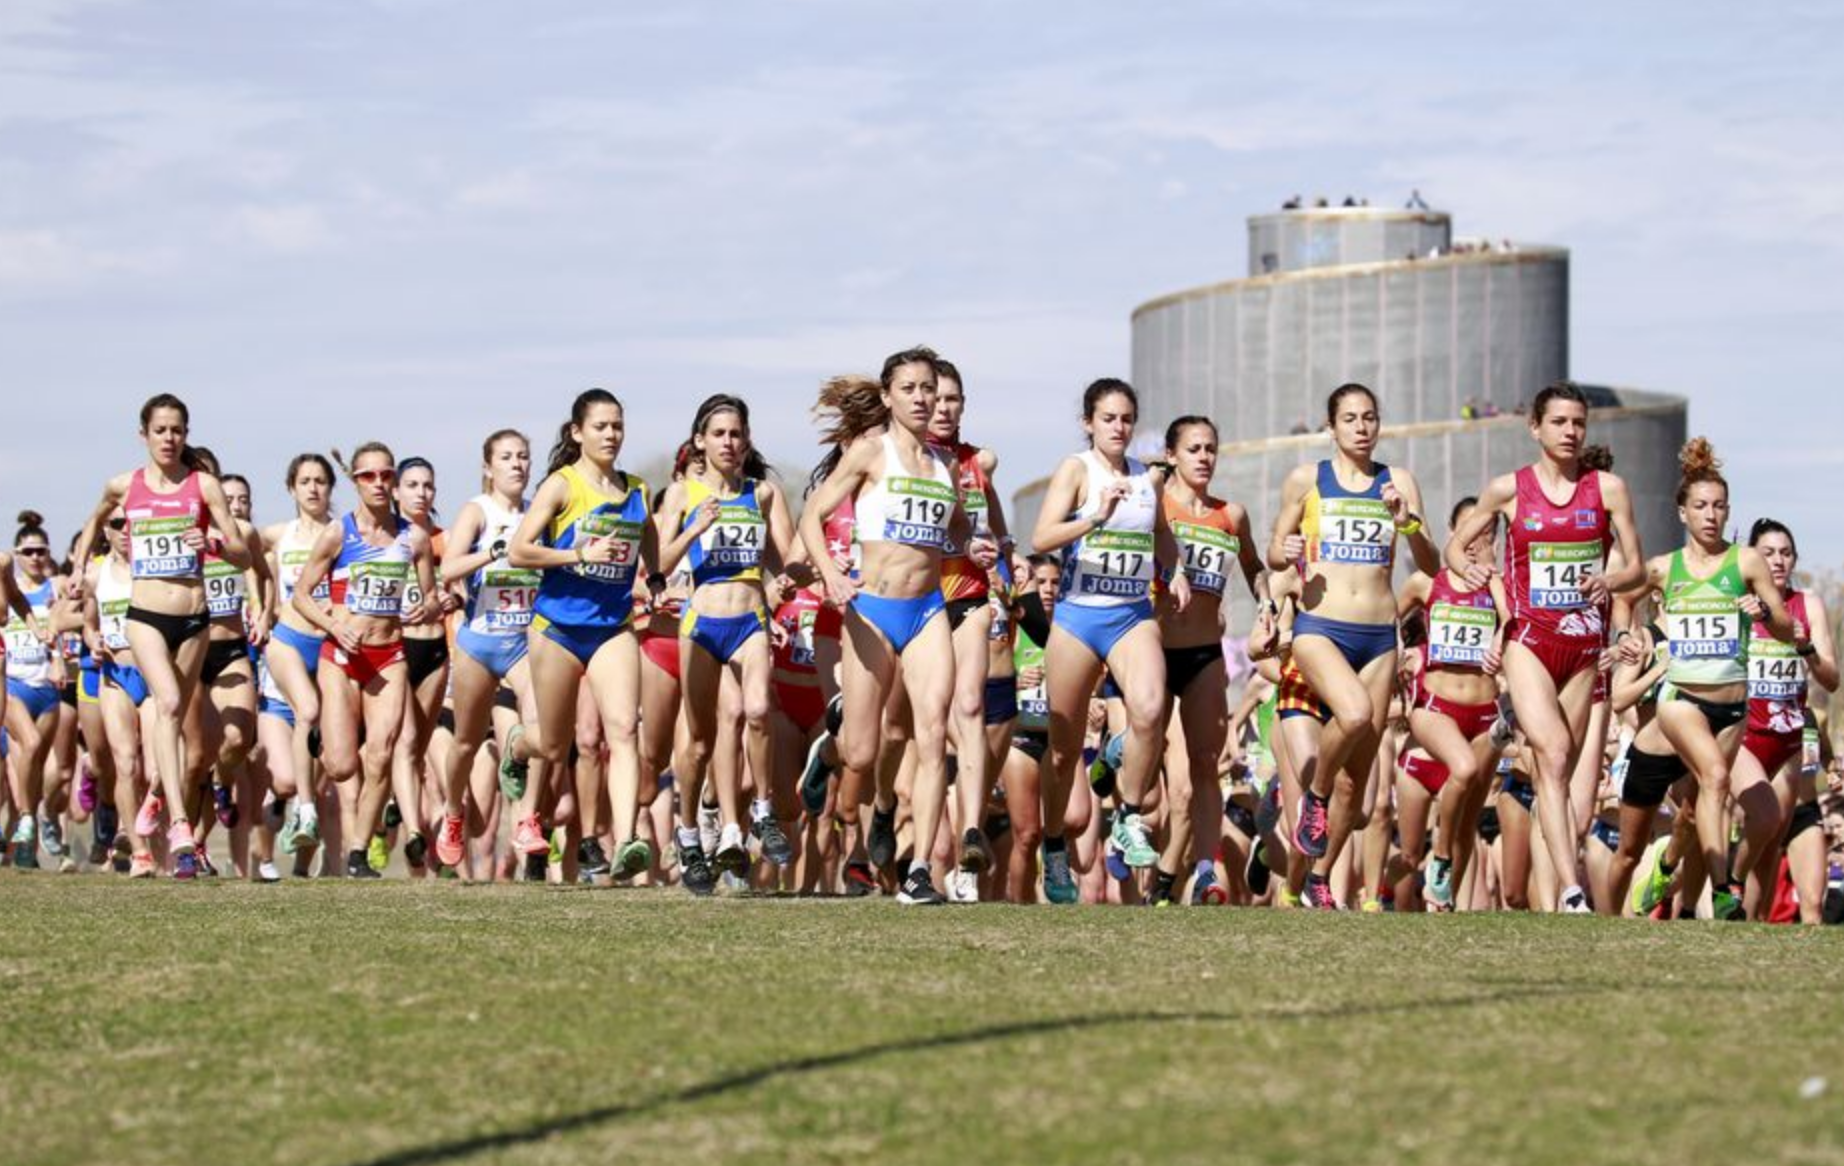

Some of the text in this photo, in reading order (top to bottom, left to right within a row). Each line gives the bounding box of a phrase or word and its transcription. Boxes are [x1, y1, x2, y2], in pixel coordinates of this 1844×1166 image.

[902, 497, 946, 524] 119
[714, 525, 758, 547] 124
[1335, 519, 1383, 543] 152
[143, 535, 184, 556] 191
[1099, 552, 1143, 577] 117
[1184, 543, 1226, 573] 161
[1544, 563, 1593, 587] 145
[1441, 624, 1482, 647] 143
[1679, 616, 1727, 638] 115
[1755, 659, 1798, 680] 144
